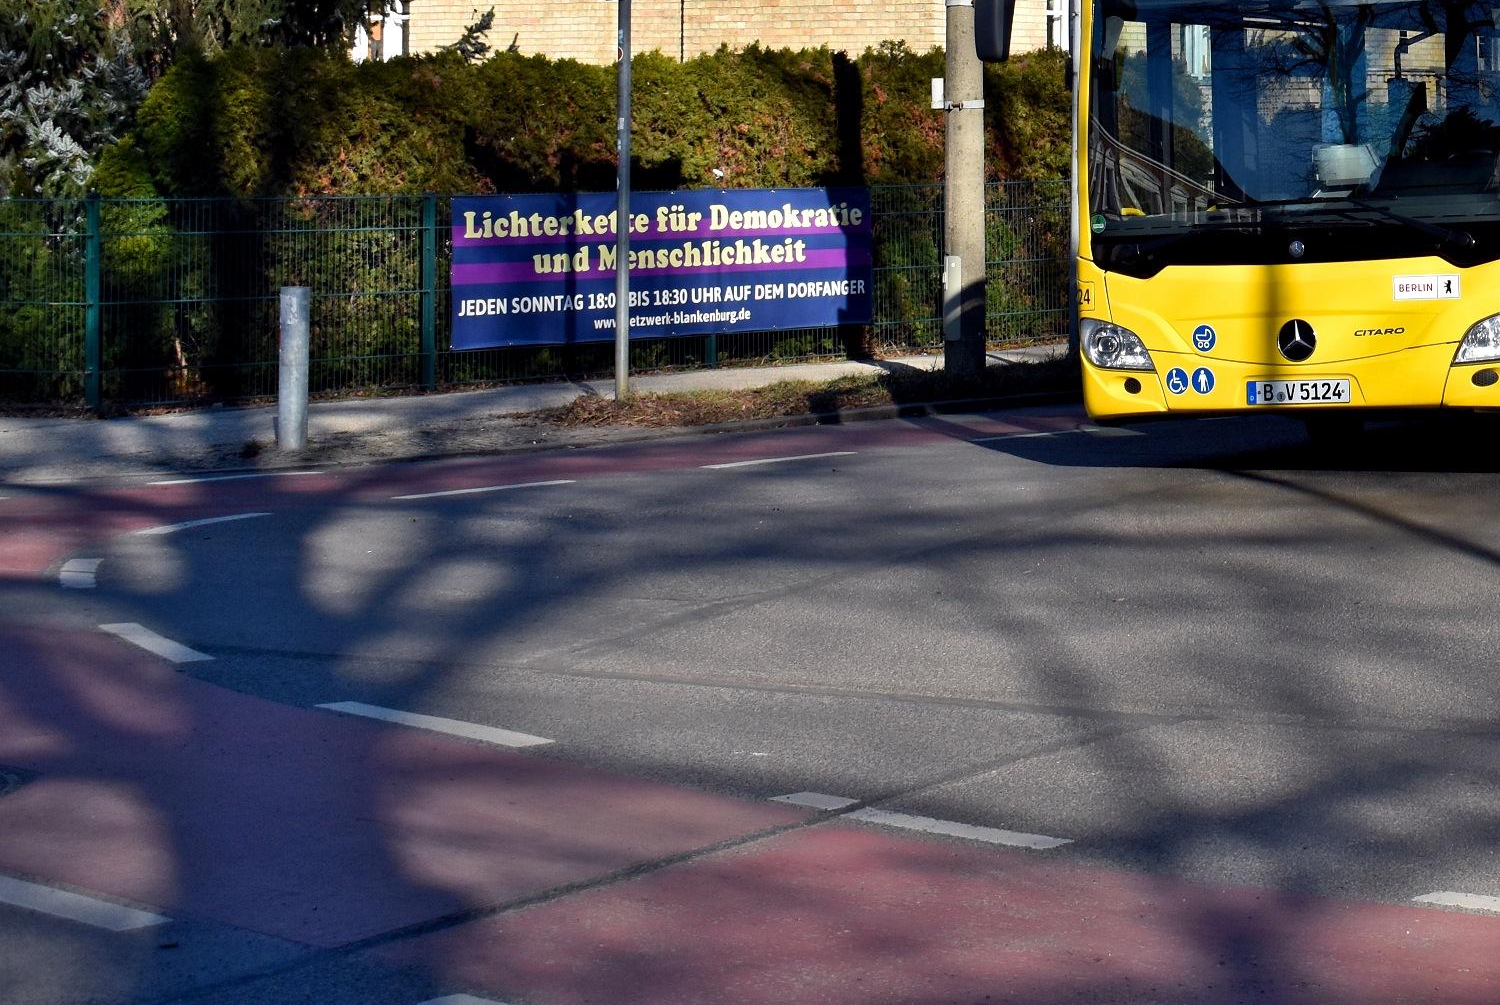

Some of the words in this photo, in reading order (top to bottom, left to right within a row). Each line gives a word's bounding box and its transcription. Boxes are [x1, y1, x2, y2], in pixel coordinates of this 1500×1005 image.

[656, 204, 702, 232] für
[709, 202, 863, 231] Demokratie
[532, 245, 591, 274] und
[458, 298, 508, 317] JEDEN
[511, 294, 584, 313] SONNTAG
[588, 292, 617, 310] 18:0
[628, 290, 650, 307] BIS
[653, 288, 688, 306] 18:30
[691, 286, 722, 304] UHR
[723, 284, 751, 302] AUF
[754, 283, 784, 300] DEM
[787, 279, 865, 298] DORFANGER
[1398, 283, 1433, 293] BERLIN
[1354, 327, 1405, 337] CITARO
[1263, 383, 1274, 401] B
[1285, 383, 1296, 400] V
[1300, 382, 1342, 400] 5124
